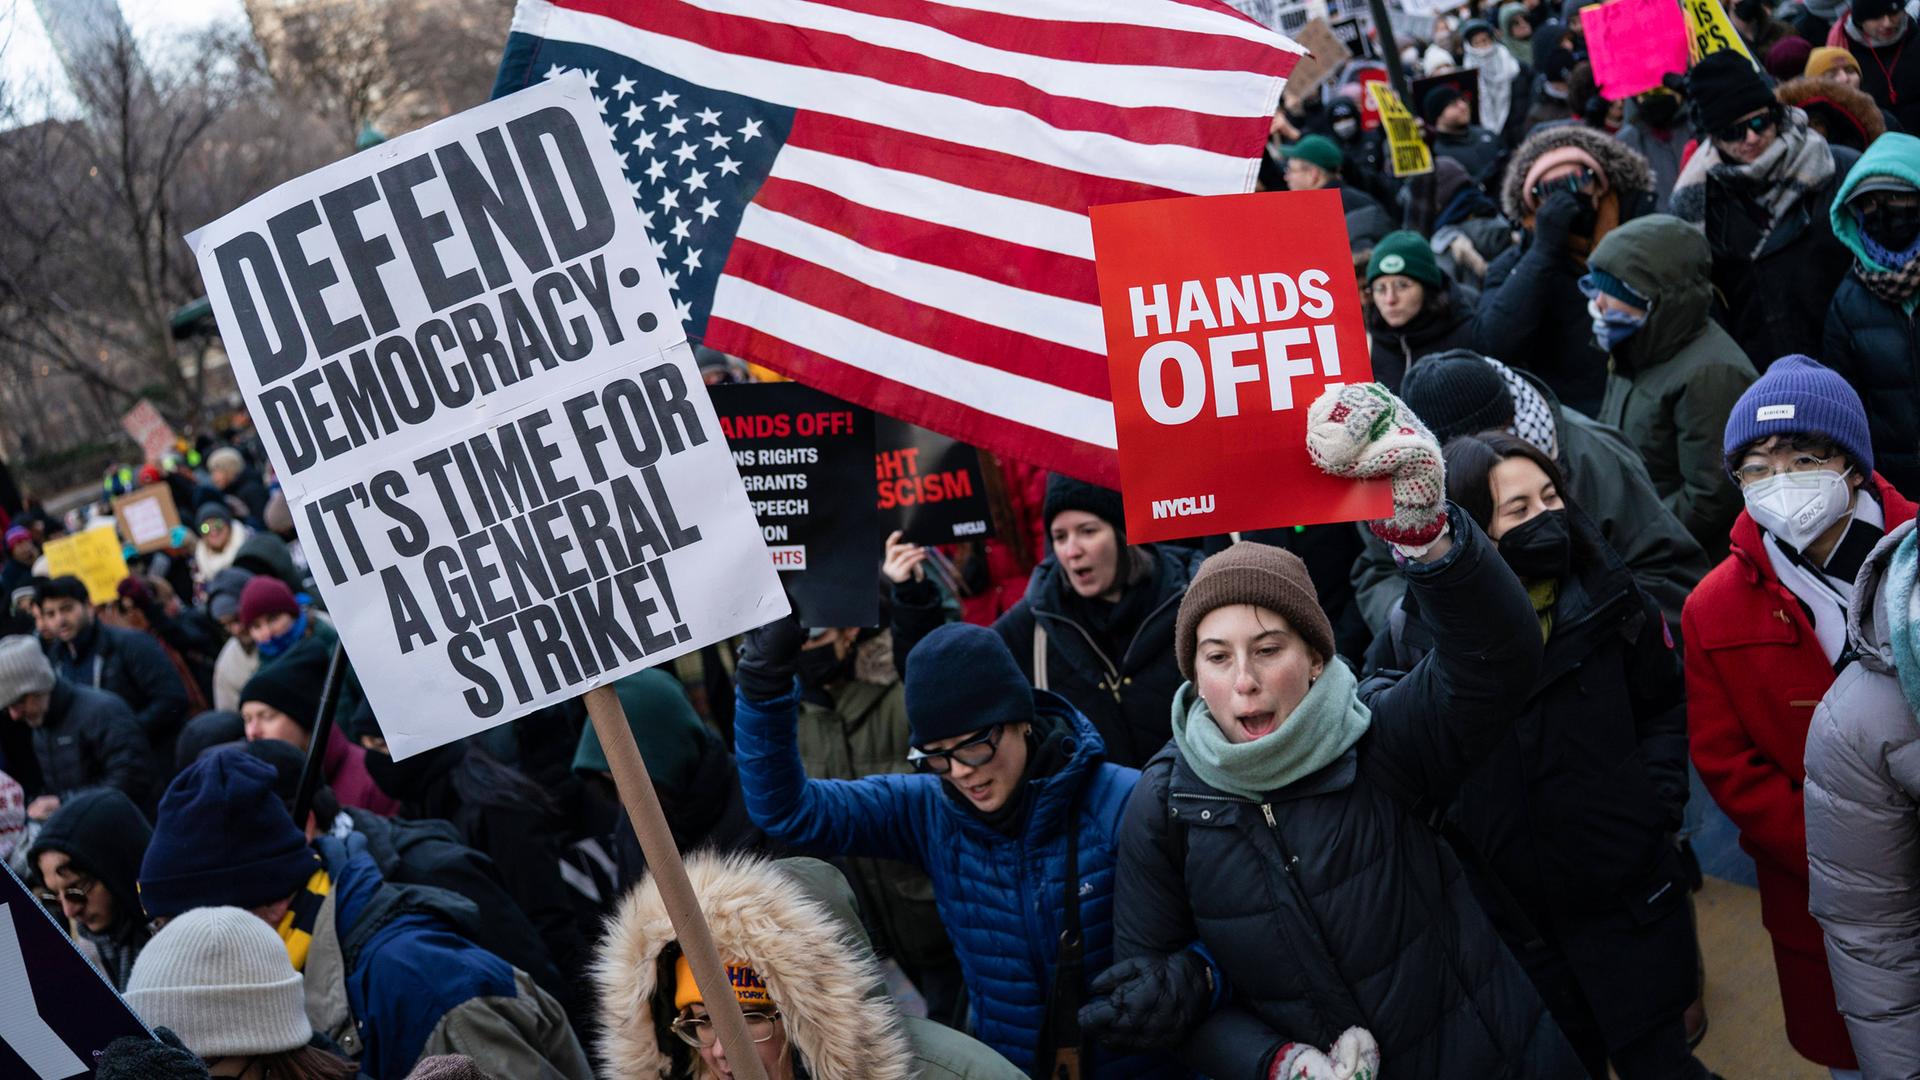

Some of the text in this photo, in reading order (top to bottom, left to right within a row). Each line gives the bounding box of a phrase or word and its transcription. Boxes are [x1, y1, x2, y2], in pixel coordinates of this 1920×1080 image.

[1691, 1, 1713, 27] IS
[214, 105, 616, 387] DEFEND
[1128, 268, 1335, 338] HANDS
[257, 254, 659, 476] DEMOCRACY:
[1138, 324, 1346, 426] OFF!
[758, 447, 819, 466] RIGHTS
[796, 411, 854, 436] OFF!
[304, 362, 709, 587] IT'S TIME FOR
[877, 467, 974, 510] SCISM
[1151, 494, 1216, 520] NYCLU
[379, 464, 703, 655] A GENERAL
[770, 550, 803, 566] HTS
[446, 556, 693, 719] STRIKE!
